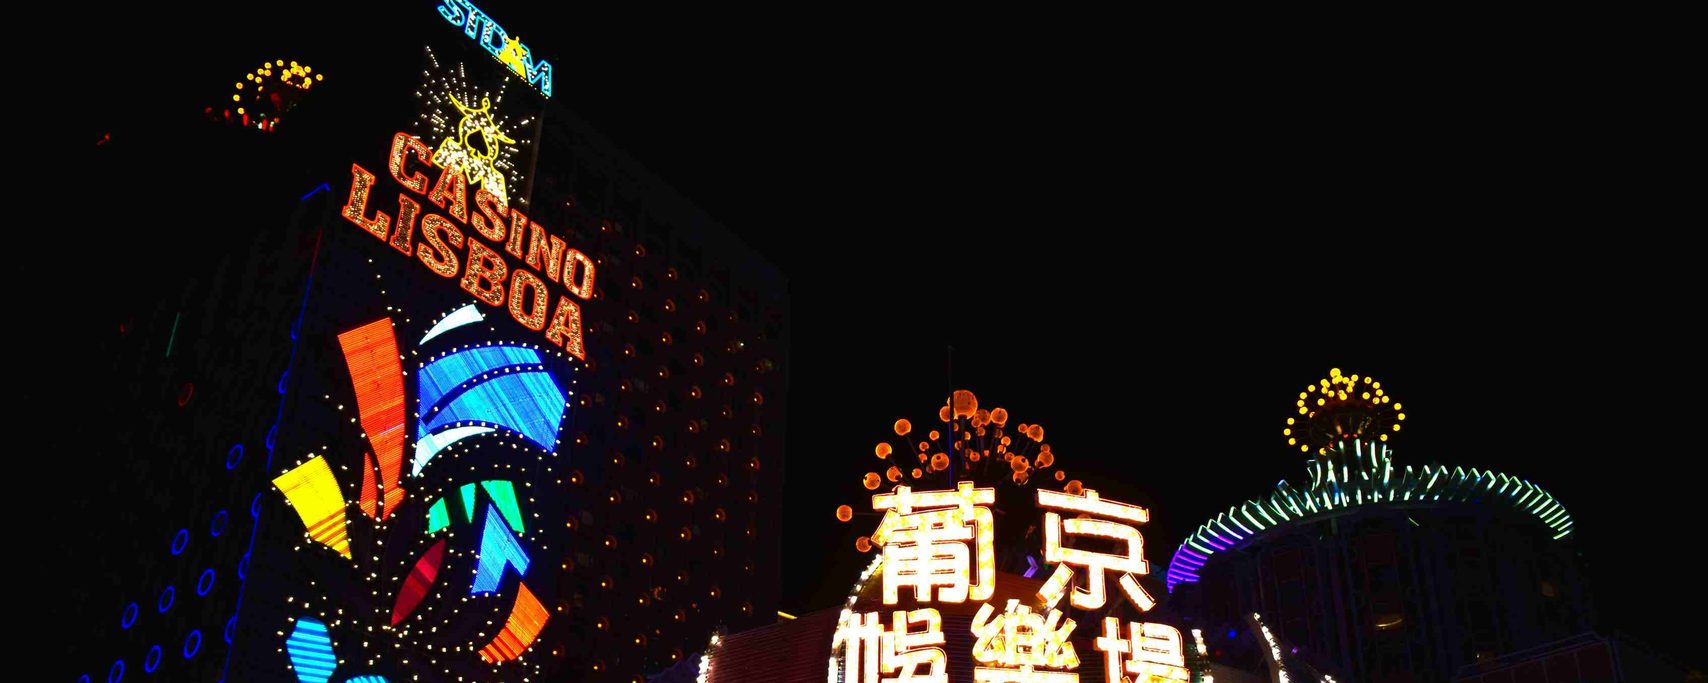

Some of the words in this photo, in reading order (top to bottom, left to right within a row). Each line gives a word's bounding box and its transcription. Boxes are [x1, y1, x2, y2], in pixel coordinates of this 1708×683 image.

[342, 163, 586, 360] LISBOA
[389, 132, 595, 299] CASINO
[871, 481, 1156, 612] 葡京
